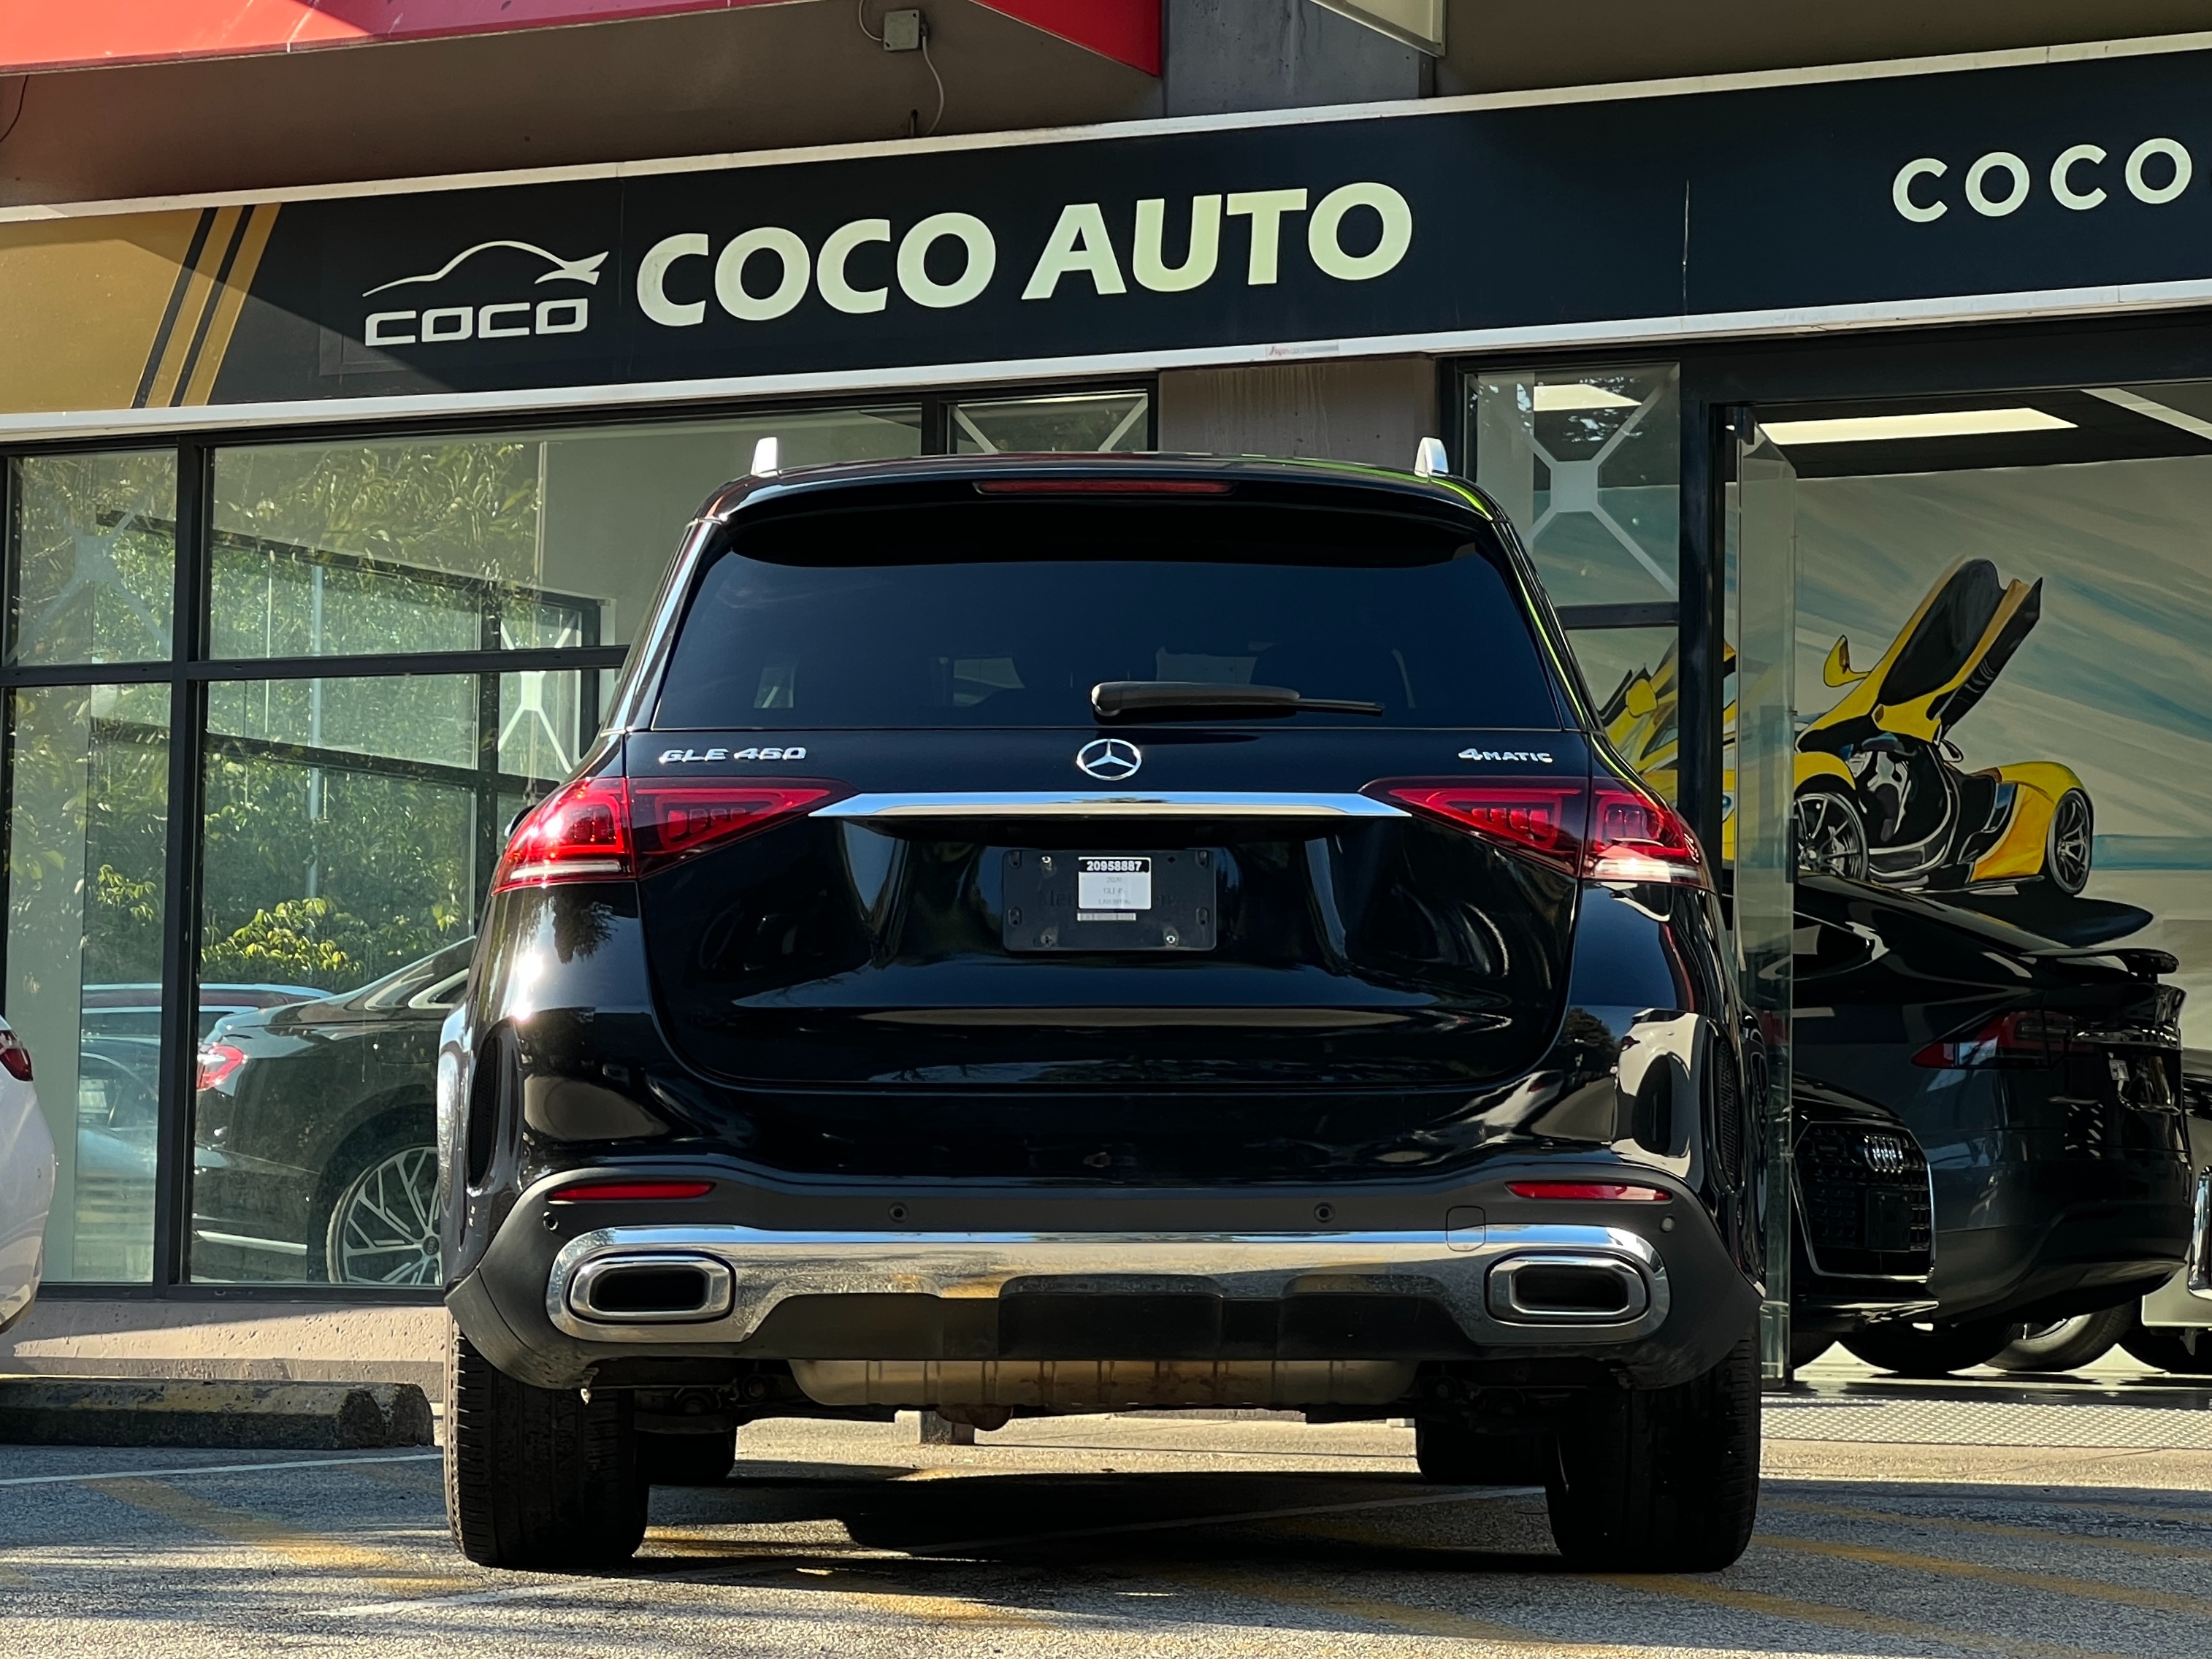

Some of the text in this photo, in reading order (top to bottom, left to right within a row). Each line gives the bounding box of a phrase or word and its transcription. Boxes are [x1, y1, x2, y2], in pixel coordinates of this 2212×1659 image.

[1892, 137, 2193, 223] COCO
[636, 181, 1413, 327] COCO AUTO
[364, 298, 589, 346] COCO
[659, 747, 807, 763] GLE 450
[1458, 748, 1553, 763] 4MATIC
